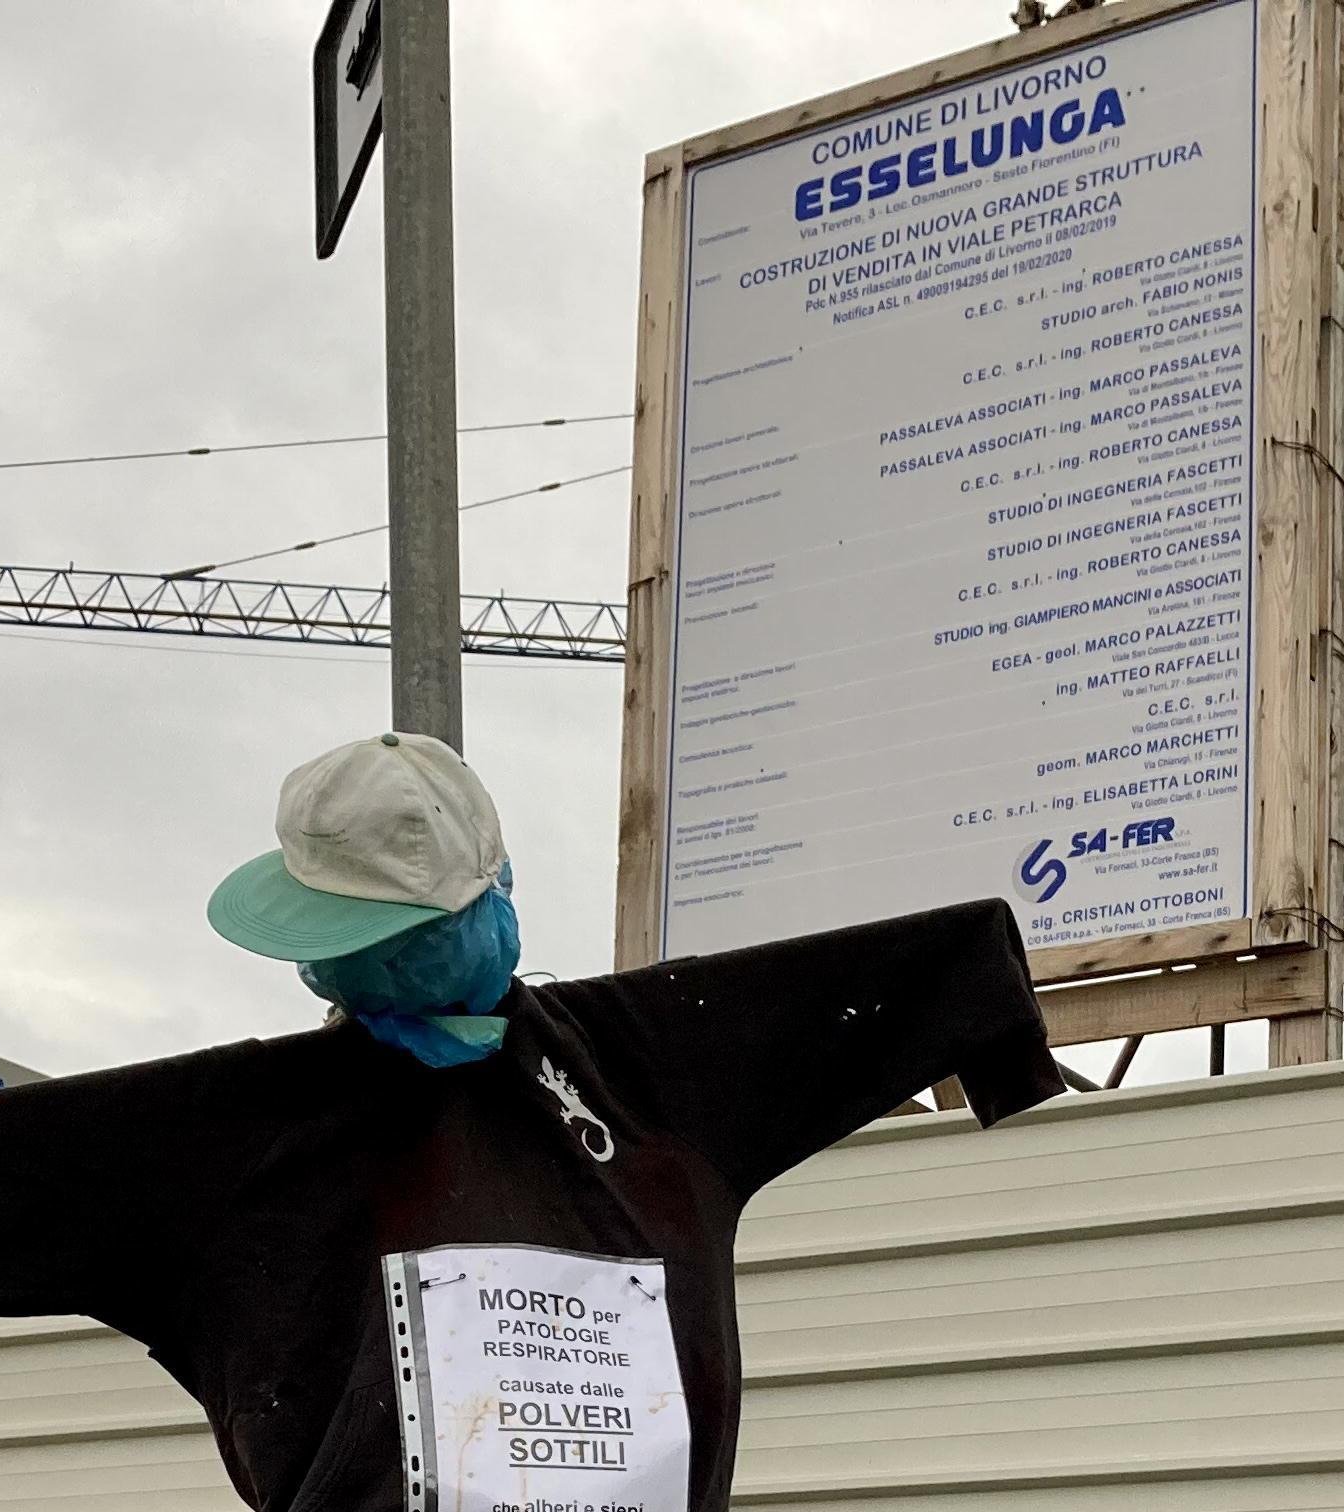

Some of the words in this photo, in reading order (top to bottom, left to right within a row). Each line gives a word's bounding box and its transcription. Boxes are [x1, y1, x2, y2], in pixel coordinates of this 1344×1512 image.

[812, 108, 932, 165] COMUNE
[941, 97, 967, 126] DI
[976, 55, 1107, 115] LIVORNO
[794, 87, 1126, 222] ESSELUNGA
[739, 235, 876, 289] COSTRUZIONE
[881, 228, 900, 249] DI
[906, 207, 977, 242] NUOVA
[983, 179, 1068, 218] GRANDE
[1075, 141, 1203, 192] STRUTTURA
[808, 275, 827, 295] DI
[832, 250, 917, 288] VENDITA
[922, 241, 942, 263] IN
[947, 224, 1005, 255] VIALE
[1011, 191, 1122, 238] PETRARCA
[805, 297, 826, 313] Pdc
[828, 286, 859, 306] N.955
[861, 274, 912, 297] rilasciato
[914, 265, 932, 282] dal
[934, 255, 982, 276] Comune
[984, 247, 996, 263] di
[998, 237, 1043, 259] Livorno
[1045, 231, 1053, 245] il
[832, 305, 875, 325] Notifica
[877, 295, 900, 313] ASL
[903, 295, 914, 305] n.
[991, 264, 1009, 281] del
[964, 299, 1009, 320] C.E.C.
[1017, 287, 1049, 306] s.r.l.
[1061, 279, 1088, 294] ing.
[1092, 255, 1165, 286] ROBERTO
[1169, 234, 1243, 264] CANESSA
[1041, 305, 1097, 331] STUDIO
[1101, 296, 1139, 315] arch.
[1143, 281, 1189, 305] FABIO
[1193, 266, 1243, 291] NONIS
[962, 364, 1007, 385] C.E.C.
[1015, 353, 1049, 372] s.r.l.
[1060, 346, 1087, 360] ing.
[1091, 322, 1164, 353] ROBERTO
[1168, 303, 1243, 332] CANESSA
[879, 413, 964, 446] PASSALEVA
[967, 392, 1046, 424] ASSOCIATI
[1059, 387, 1084, 401] ing.
[1089, 368, 1145, 393] MARCO
[1149, 343, 1242, 378] PASSALEVA
[880, 447, 964, 478] PASSALEVA
[967, 425, 1047, 457] ASSOCIATI
[1059, 420, 1087, 434] ing.
[1090, 402, 1146, 426] MARCO
[1150, 378, 1242, 412] PASSALEVA
[960, 472, 1004, 493] C.E.C.
[1013, 463, 1046, 481] s.r.l.
[1058, 456, 1085, 470] ing.
[1089, 433, 1163, 463] ROBERTO
[1167, 415, 1242, 443] CANESSA
[988, 500, 1044, 525] STUDIO
[1047, 495, 1063, 511] DI
[1067, 473, 1163, 507] INGEGNERIA
[1167, 453, 1243, 483] FASCETTI
[987, 538, 1043, 561] STUDIO
[1047, 533, 1062, 549] DI
[1066, 511, 1162, 544] INGEGNERIA
[1167, 492, 1242, 521] FASCETTI
[958, 582, 1003, 602] C.E.C.
[1011, 572, 1044, 591] s.r.l.
[1056, 567, 1083, 581] ing.
[1087, 546, 1162, 574] ROBERTO
[1166, 528, 1241, 556] CANESSA
[934, 624, 984, 646] STUDIO
[988, 621, 1011, 635] ing.
[1013, 601, 1090, 629] GIAMPIERO
[1092, 588, 1152, 612] MANCINI
[1153, 588, 1163, 599] e
[1165, 568, 1242, 597] ASSOCIATI
[992, 652, 1032, 673] EGEA
[1045, 643, 1082, 665] geol.
[1085, 630, 1141, 653] MARCO
[1145, 608, 1241, 641] PALAZZETTI
[1056, 682, 1083, 696] ing.
[1087, 665, 1150, 690] MATTEO
[1155, 646, 1240, 676] RAFFAELLI
[1147, 696, 1196, 717] C.E.C.
[1205, 687, 1240, 706] s.r.l.
[1036, 758, 1082, 777] geom.
[1085, 743, 1142, 765] MARCO
[1146, 724, 1239, 754] MARCHETTI
[953, 808, 998, 827] C.E.C.
[1006, 800, 1040, 818] s.r.l.
[1052, 796, 1080, 811] ing.
[1083, 775, 1179, 804] ELISABETTA
[1183, 764, 1238, 786] LORINI
[1066, 816, 1175, 859] SA-FER
[1158, 862, 1218, 881] www.sa-fer.it
[1031, 915, 1058, 931] sig.
[1062, 901, 1135, 924] CRISTIAN
[1139, 886, 1224, 912] OTTOBONI
[478, 1288, 586, 1320] MORTO
[592, 1307, 621, 1327] per
[497, 1318, 612, 1346] PATOLOGIE
[482, 1341, 631, 1368] RESPIRATORIE
[498, 1377, 575, 1396] causate
[580, 1380, 625, 1399] dalle
[498, 1401, 632, 1430] POLVERI
[509, 1437, 626, 1465] SOTTILI
